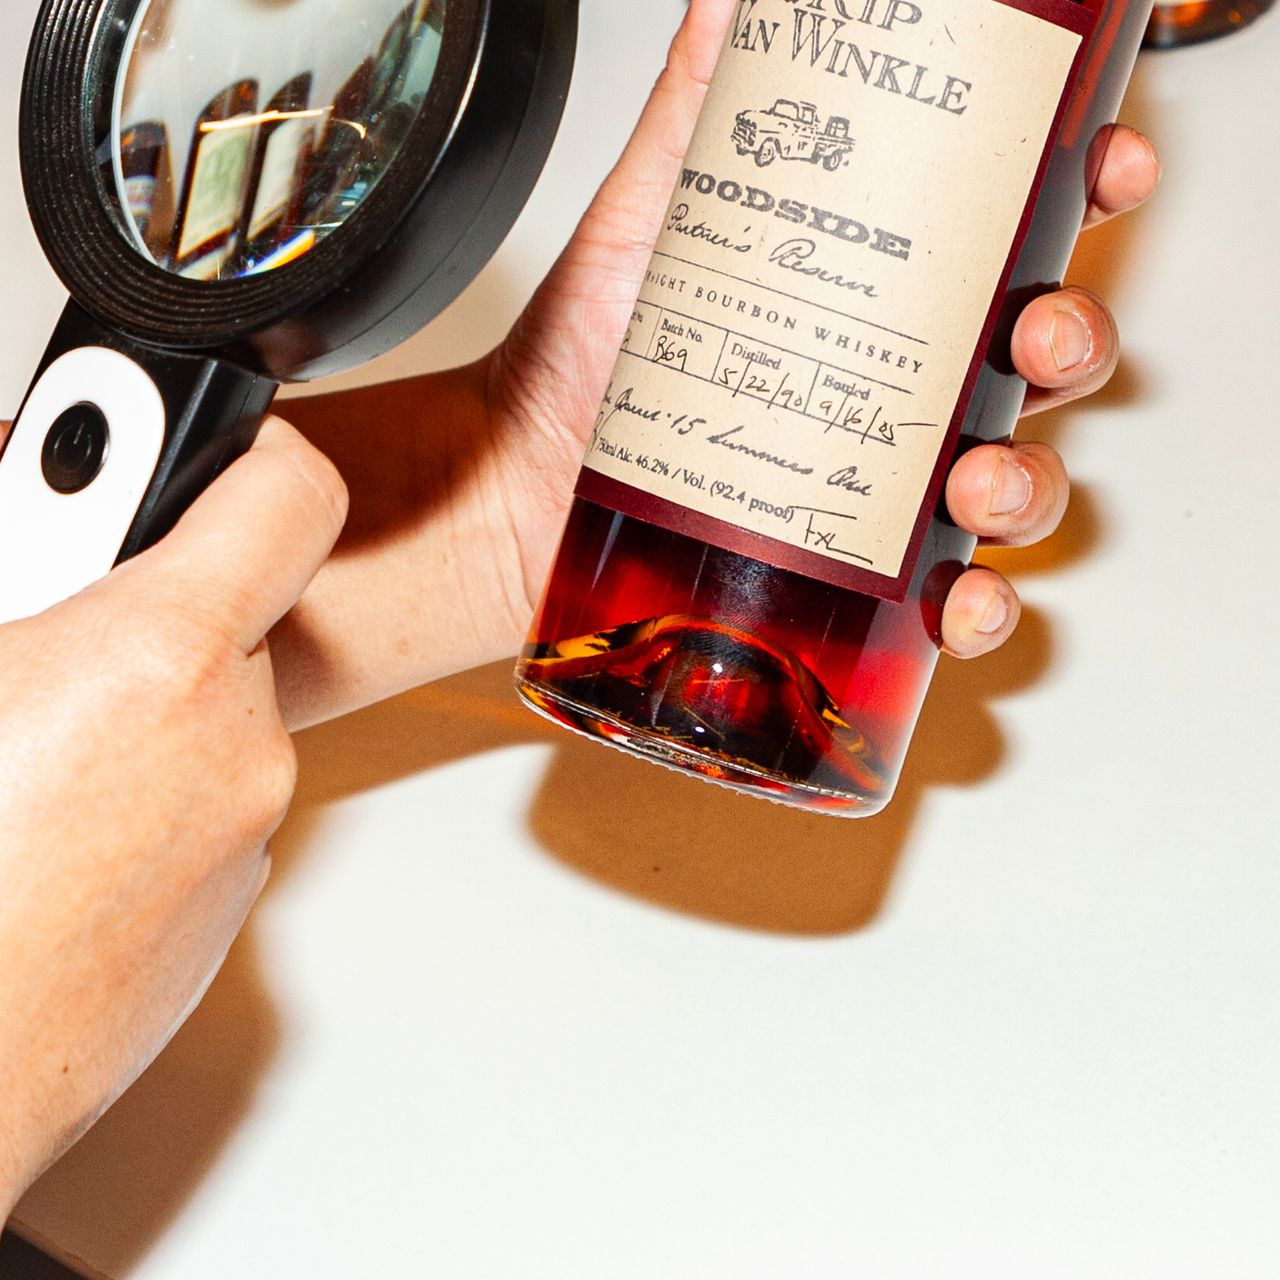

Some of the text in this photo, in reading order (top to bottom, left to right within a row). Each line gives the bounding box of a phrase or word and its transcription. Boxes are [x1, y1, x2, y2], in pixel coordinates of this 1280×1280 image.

[791, 7, 973, 116] WINKLE
[680, 168, 913, 261] WOODSIDE
[768, 237, 879, 299] Reserve
[660, 317, 685, 337] Batch
[694, 285, 797, 330] BOURBON
[814, 325, 924, 375] WHISKEY
[730, 341, 783, 371] Distilled
[821, 373, 872, 402] Bottled
[635, 454, 670, 477] 46.2%
[683, 468, 706, 491] Vol.
[709, 479, 746, 505] (92.4
[748, 496, 795, 524] proof)
